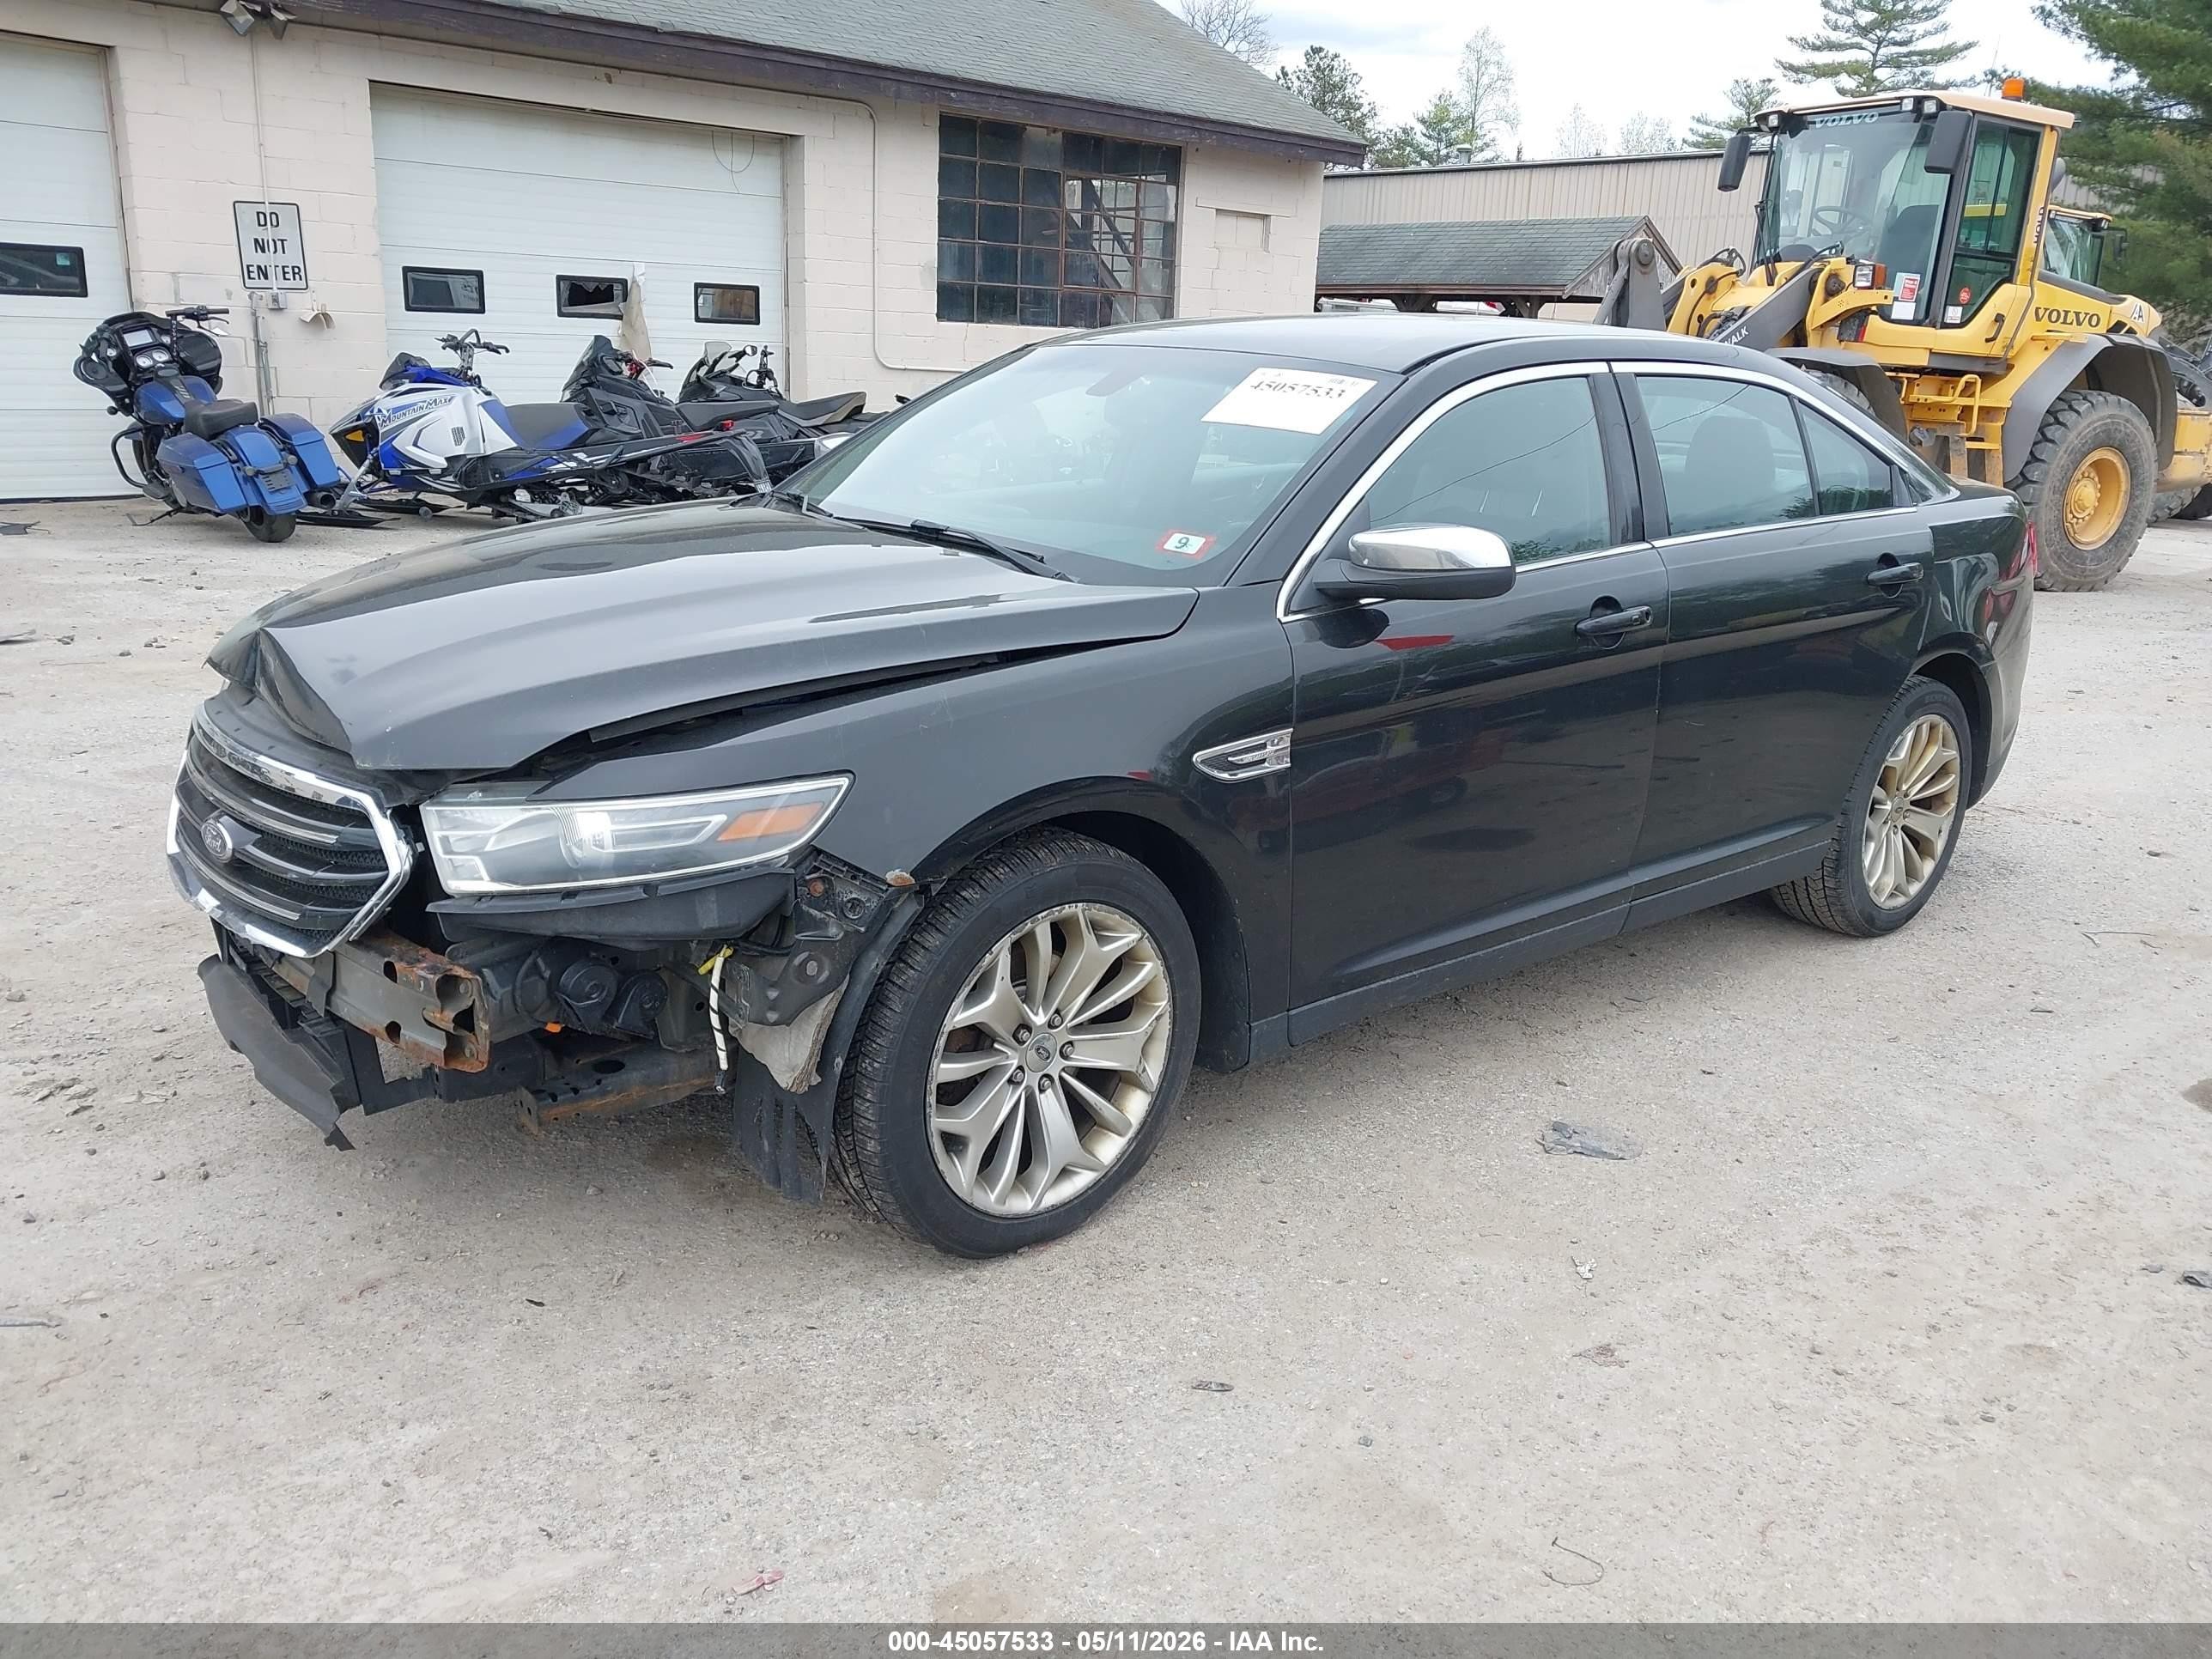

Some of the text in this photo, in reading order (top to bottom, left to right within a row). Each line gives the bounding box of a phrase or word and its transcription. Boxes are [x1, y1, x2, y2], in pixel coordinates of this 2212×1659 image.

[1814, 112, 1880, 128] VOLVO
[256, 210, 280, 228] DO
[253, 237, 288, 254] NOT
[246, 264, 302, 281] ENTER
[2034, 307, 2101, 328] VOLVO
[1175, 536, 1190, 550] 9
[204, 825, 222, 853] Ford
